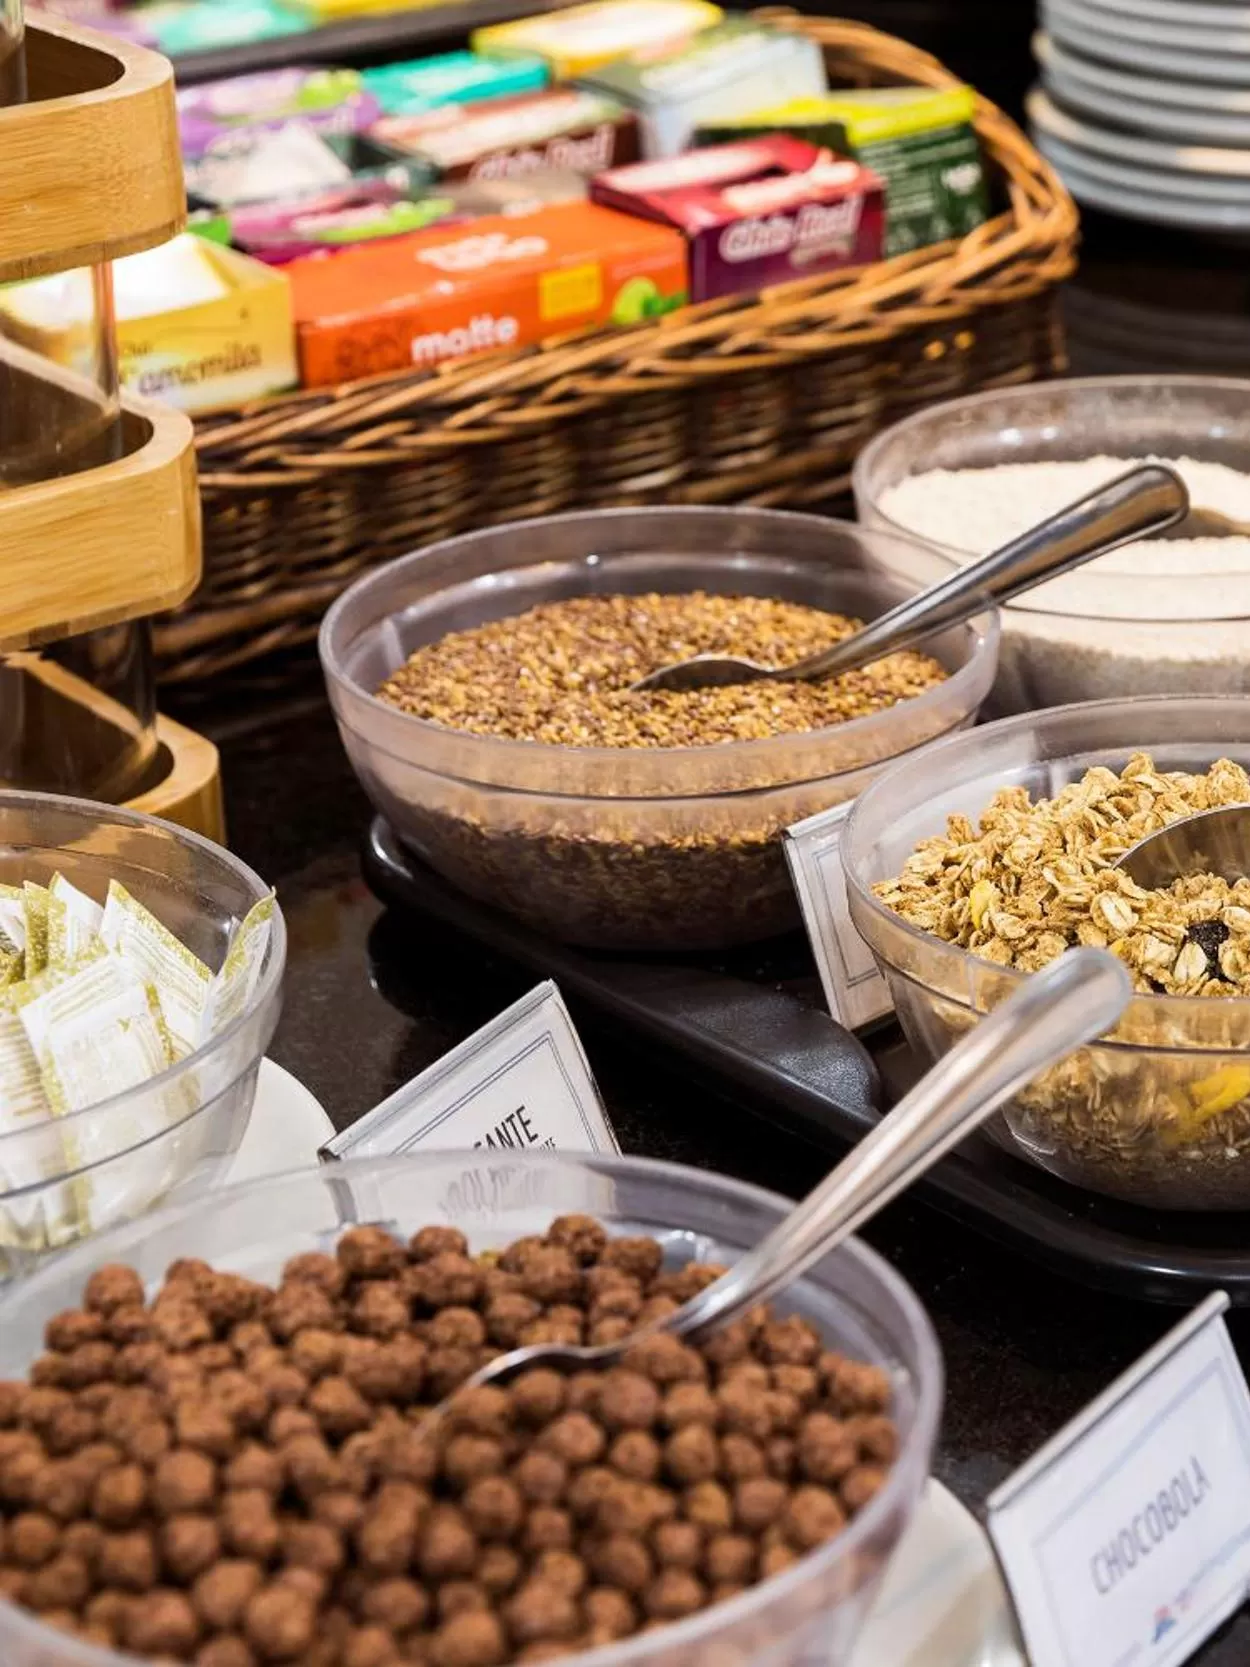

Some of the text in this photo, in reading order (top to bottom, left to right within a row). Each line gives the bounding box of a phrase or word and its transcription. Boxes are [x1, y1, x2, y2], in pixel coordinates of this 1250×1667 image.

[411, 313, 519, 364] matte
[473, 1104, 539, 1151] ANTE
[1089, 1455, 1212, 1597] CHOCOBOLA
